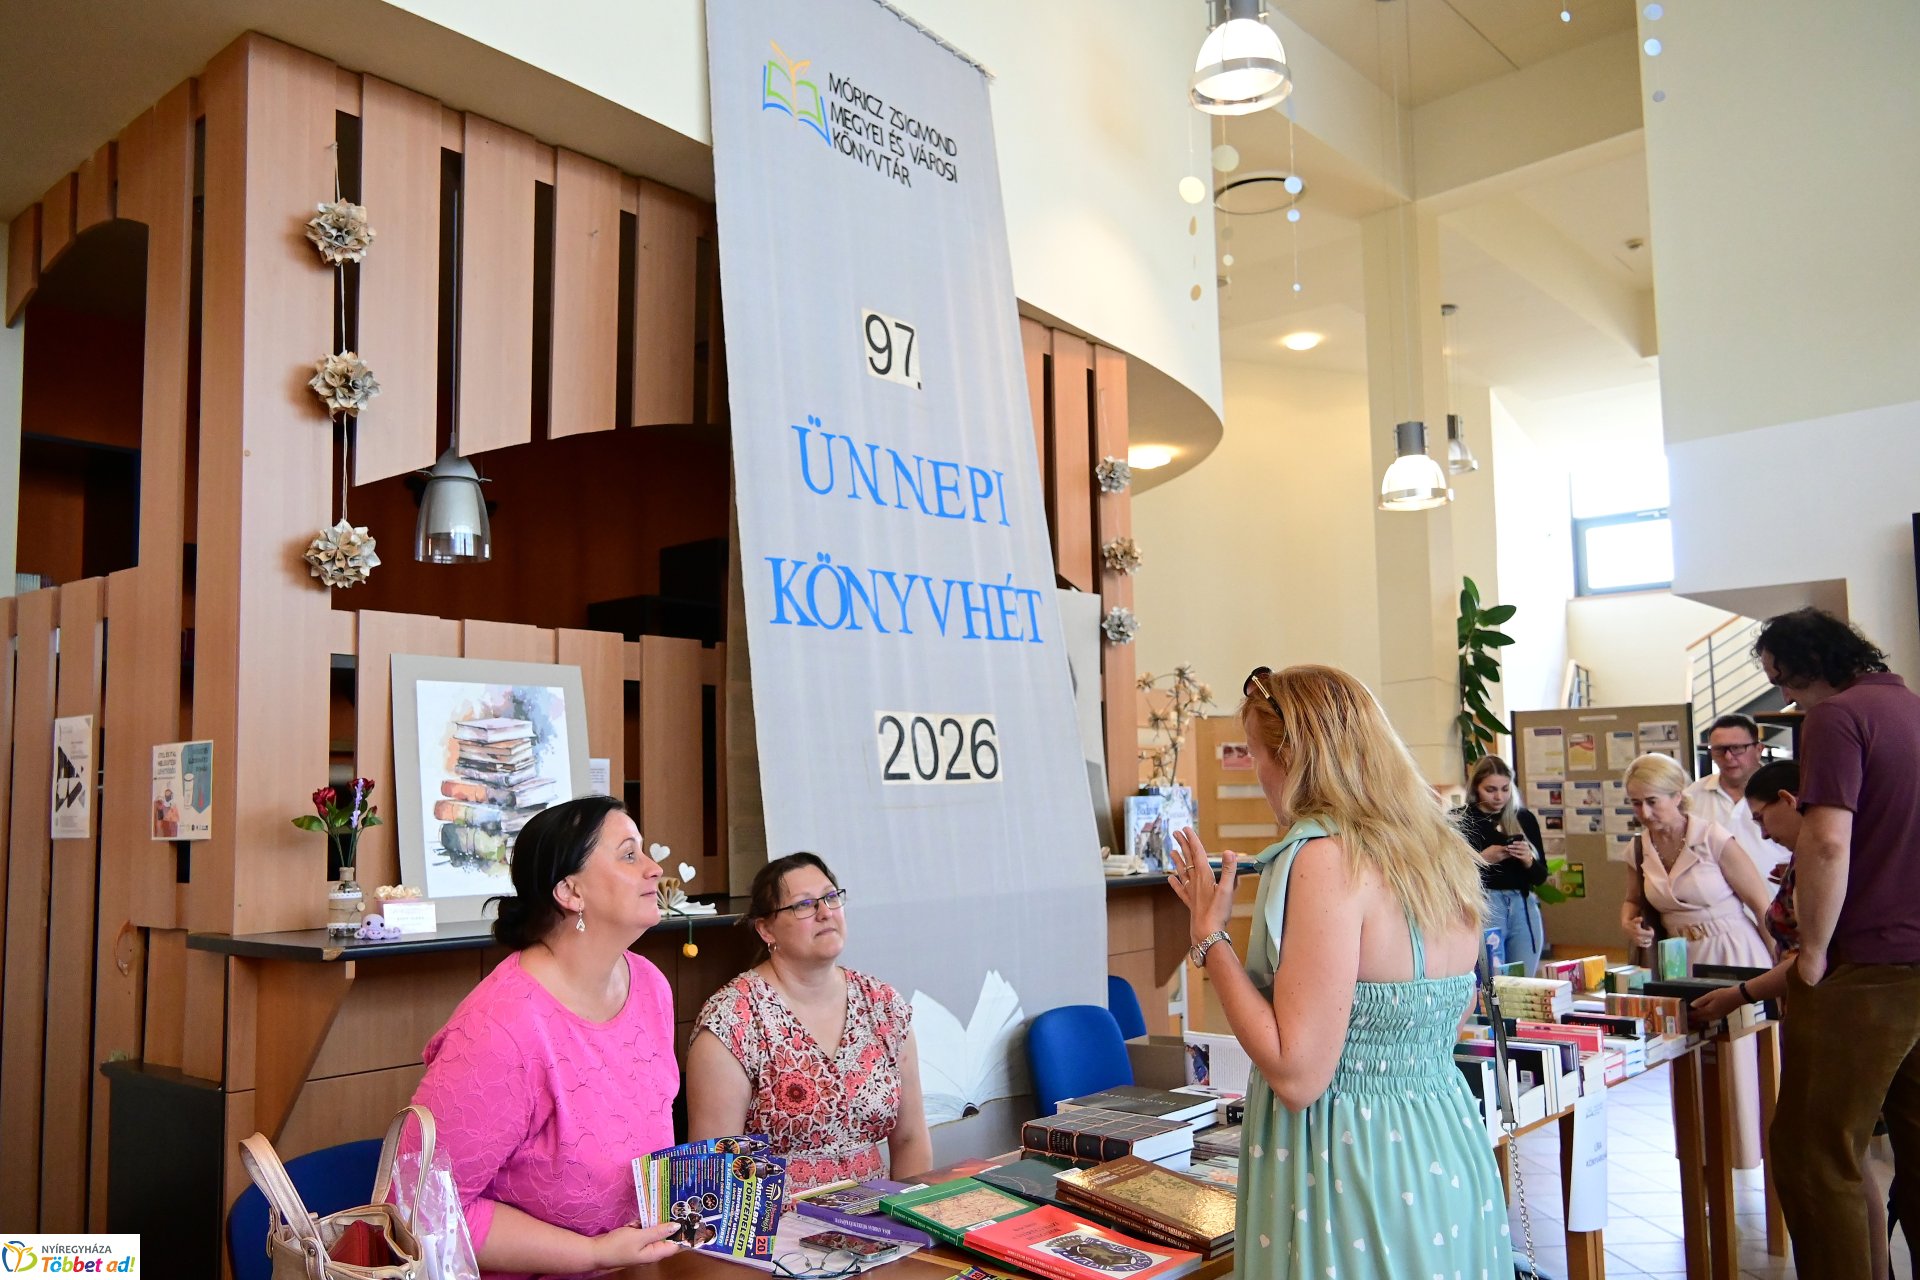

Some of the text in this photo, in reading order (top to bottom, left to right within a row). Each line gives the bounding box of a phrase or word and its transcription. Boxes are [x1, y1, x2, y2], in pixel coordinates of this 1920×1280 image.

[829, 73, 957, 157] MÓRICZ ZSIGMOND
[830, 102, 958, 183] MEGYEI ÉS VÁROSI
[832, 128, 911, 188] KÖNYVTÁR
[866, 314, 922, 390] 97.
[791, 414, 1010, 527] ÜNNEPI
[764, 551, 1044, 643] KÖNYVHÉT
[878, 715, 999, 780] 2026
